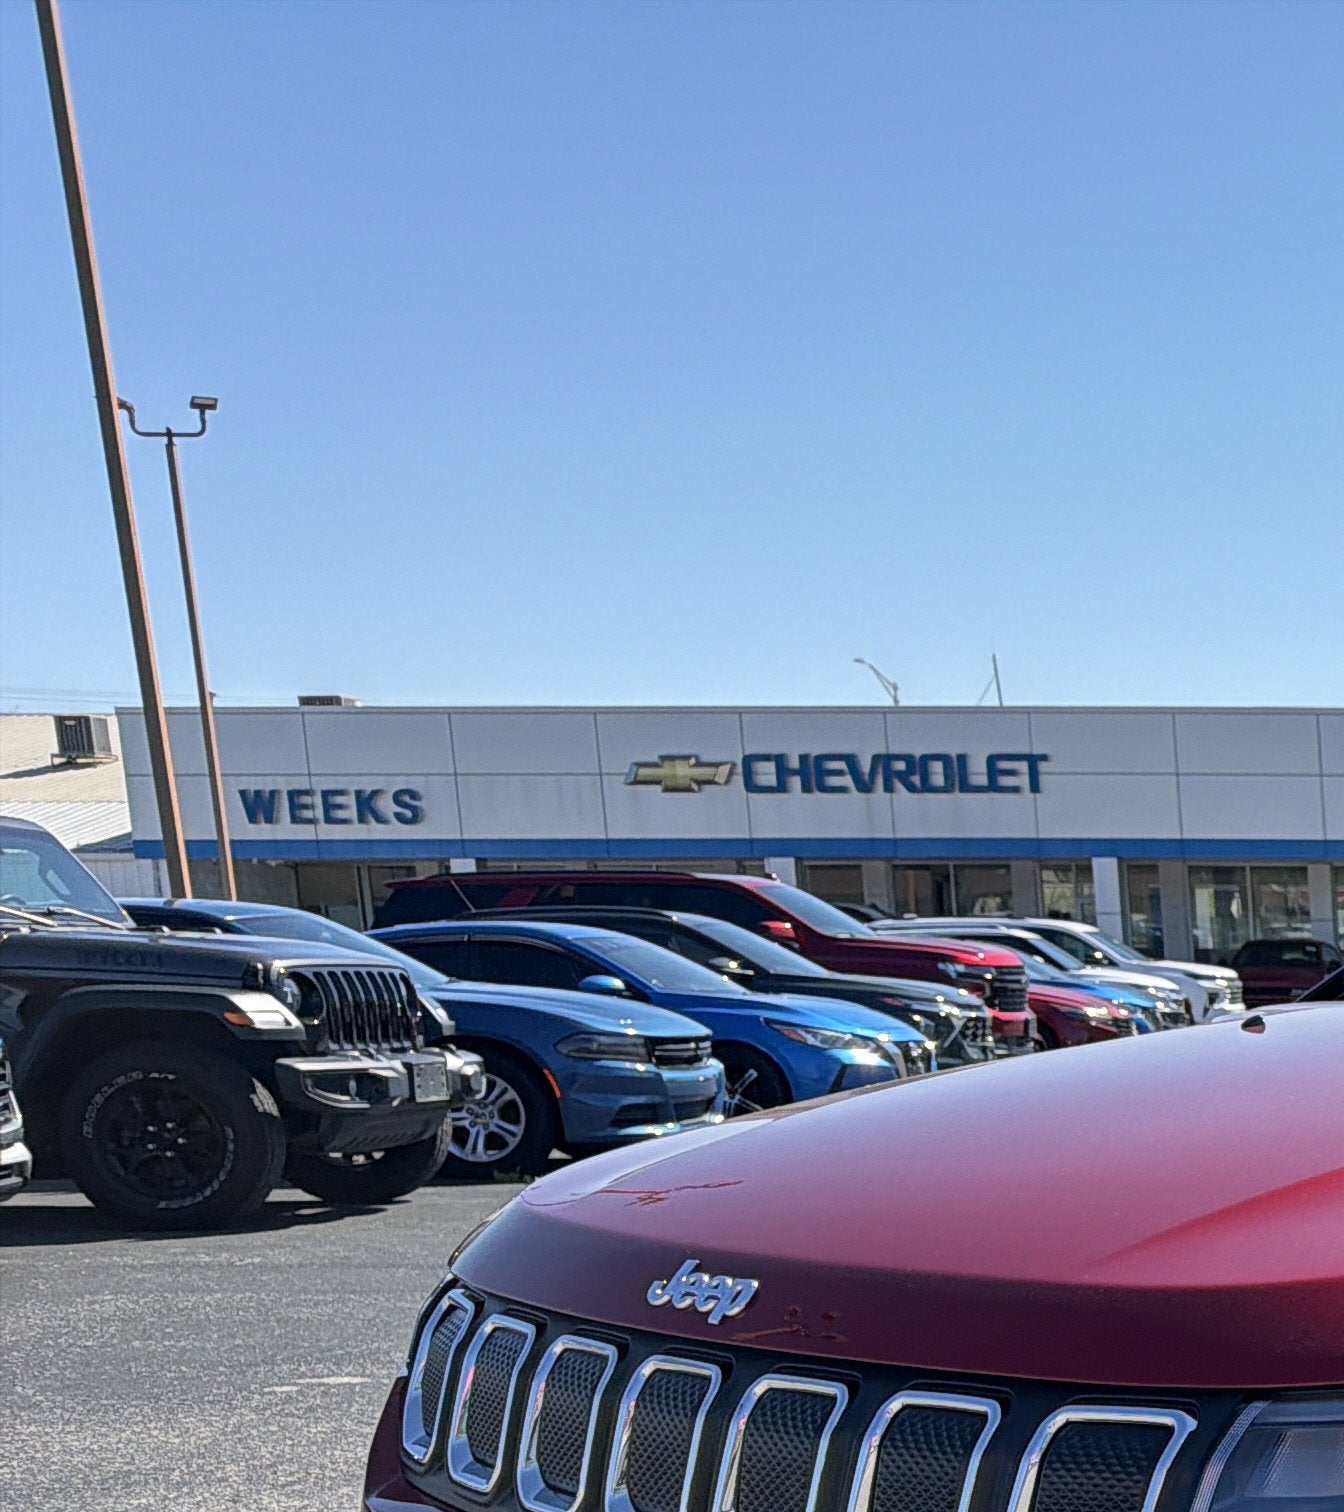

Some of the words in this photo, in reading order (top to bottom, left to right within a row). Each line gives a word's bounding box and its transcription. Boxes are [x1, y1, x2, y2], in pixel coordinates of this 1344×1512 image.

[740, 752, 1049, 794] CHEVROLET
[238, 788, 426, 825] WEEKS
[646, 1259, 760, 1326] Jeep
